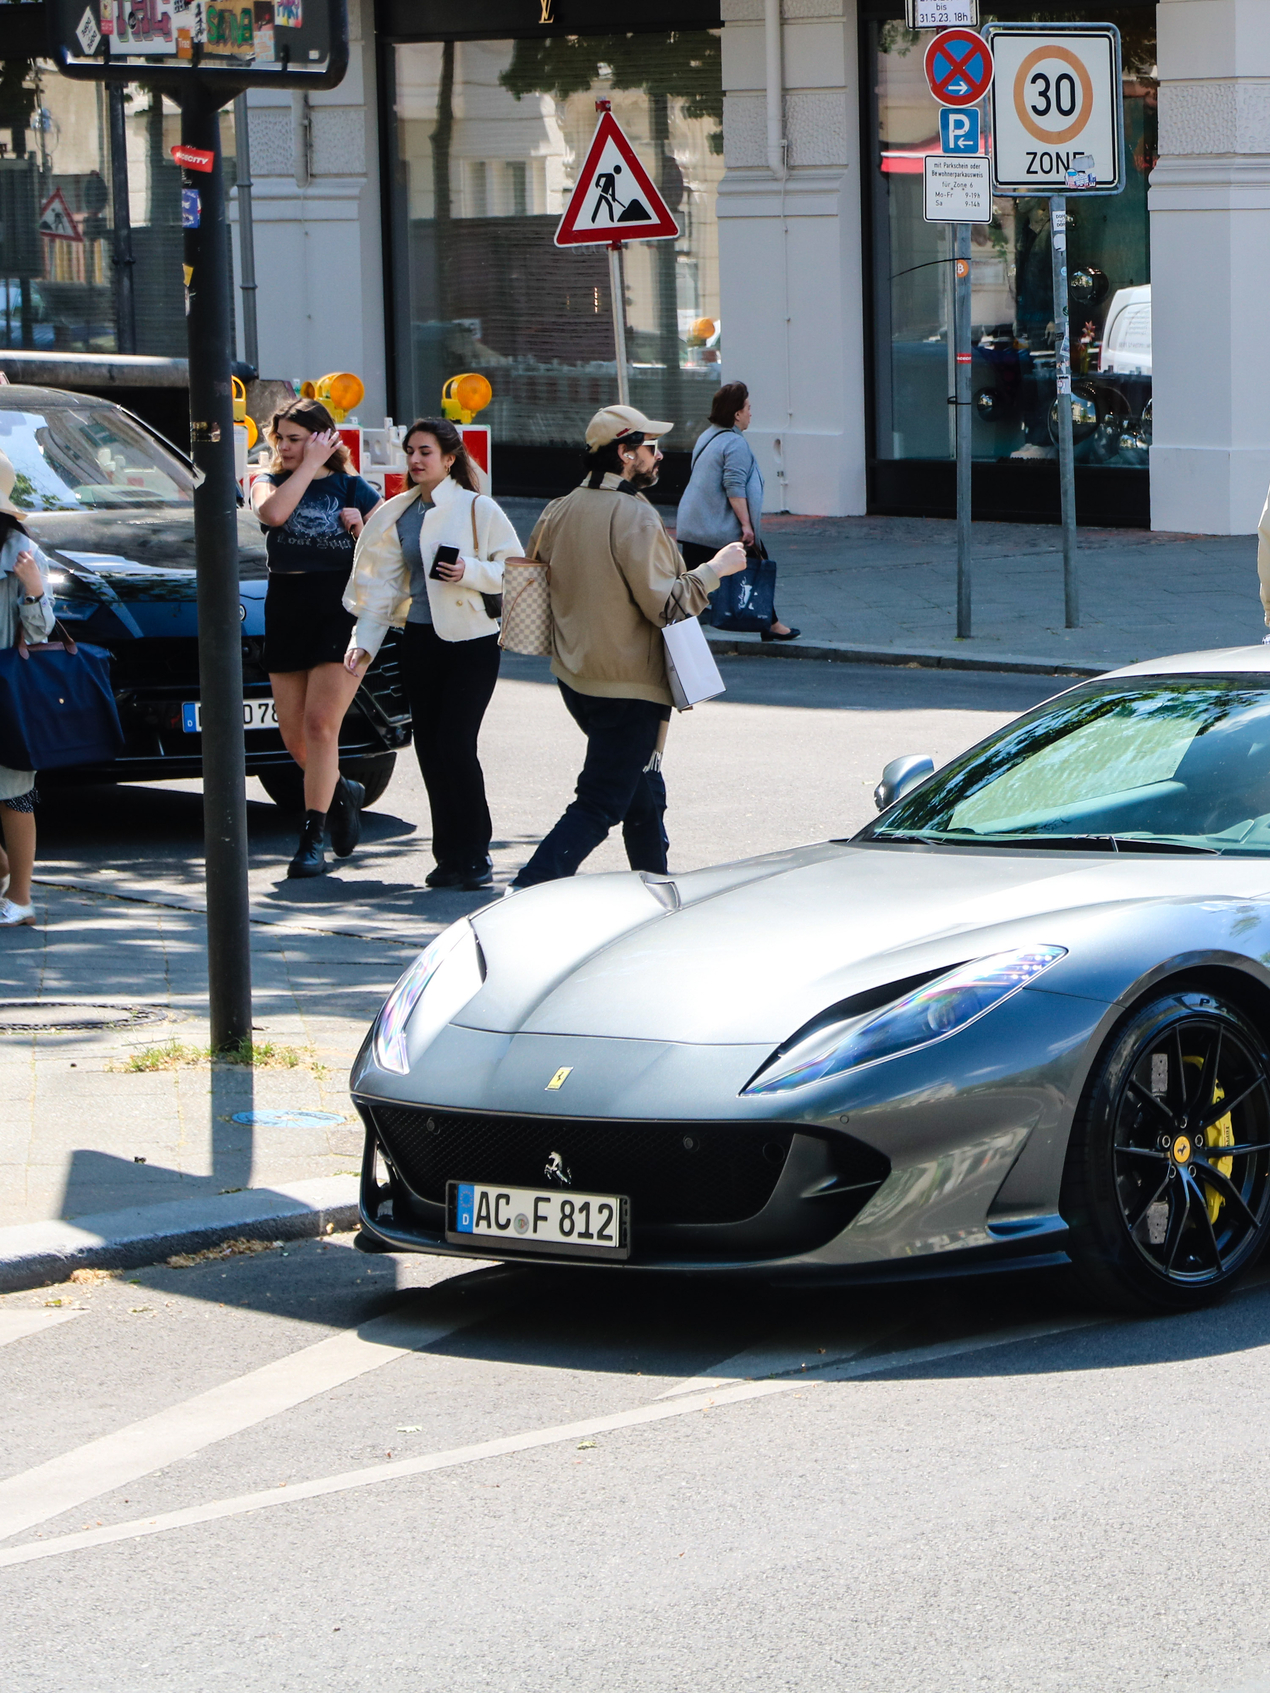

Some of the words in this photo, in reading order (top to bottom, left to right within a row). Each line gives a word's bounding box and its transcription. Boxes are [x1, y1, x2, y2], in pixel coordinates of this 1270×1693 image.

[936, 3, 947, 11] bis
[954, 12, 968, 22] 18h
[1030, 72, 1076, 117] 30
[948, 114, 970, 148] P
[943, 162, 969, 170] Parkschein
[942, 180, 951, 188] für
[953, 181, 968, 189] Zone
[462, 1213, 470, 1226] D
[475, 1191, 511, 1231] AC
[533, 1196, 551, 1234] F
[559, 1200, 614, 1242] 812
